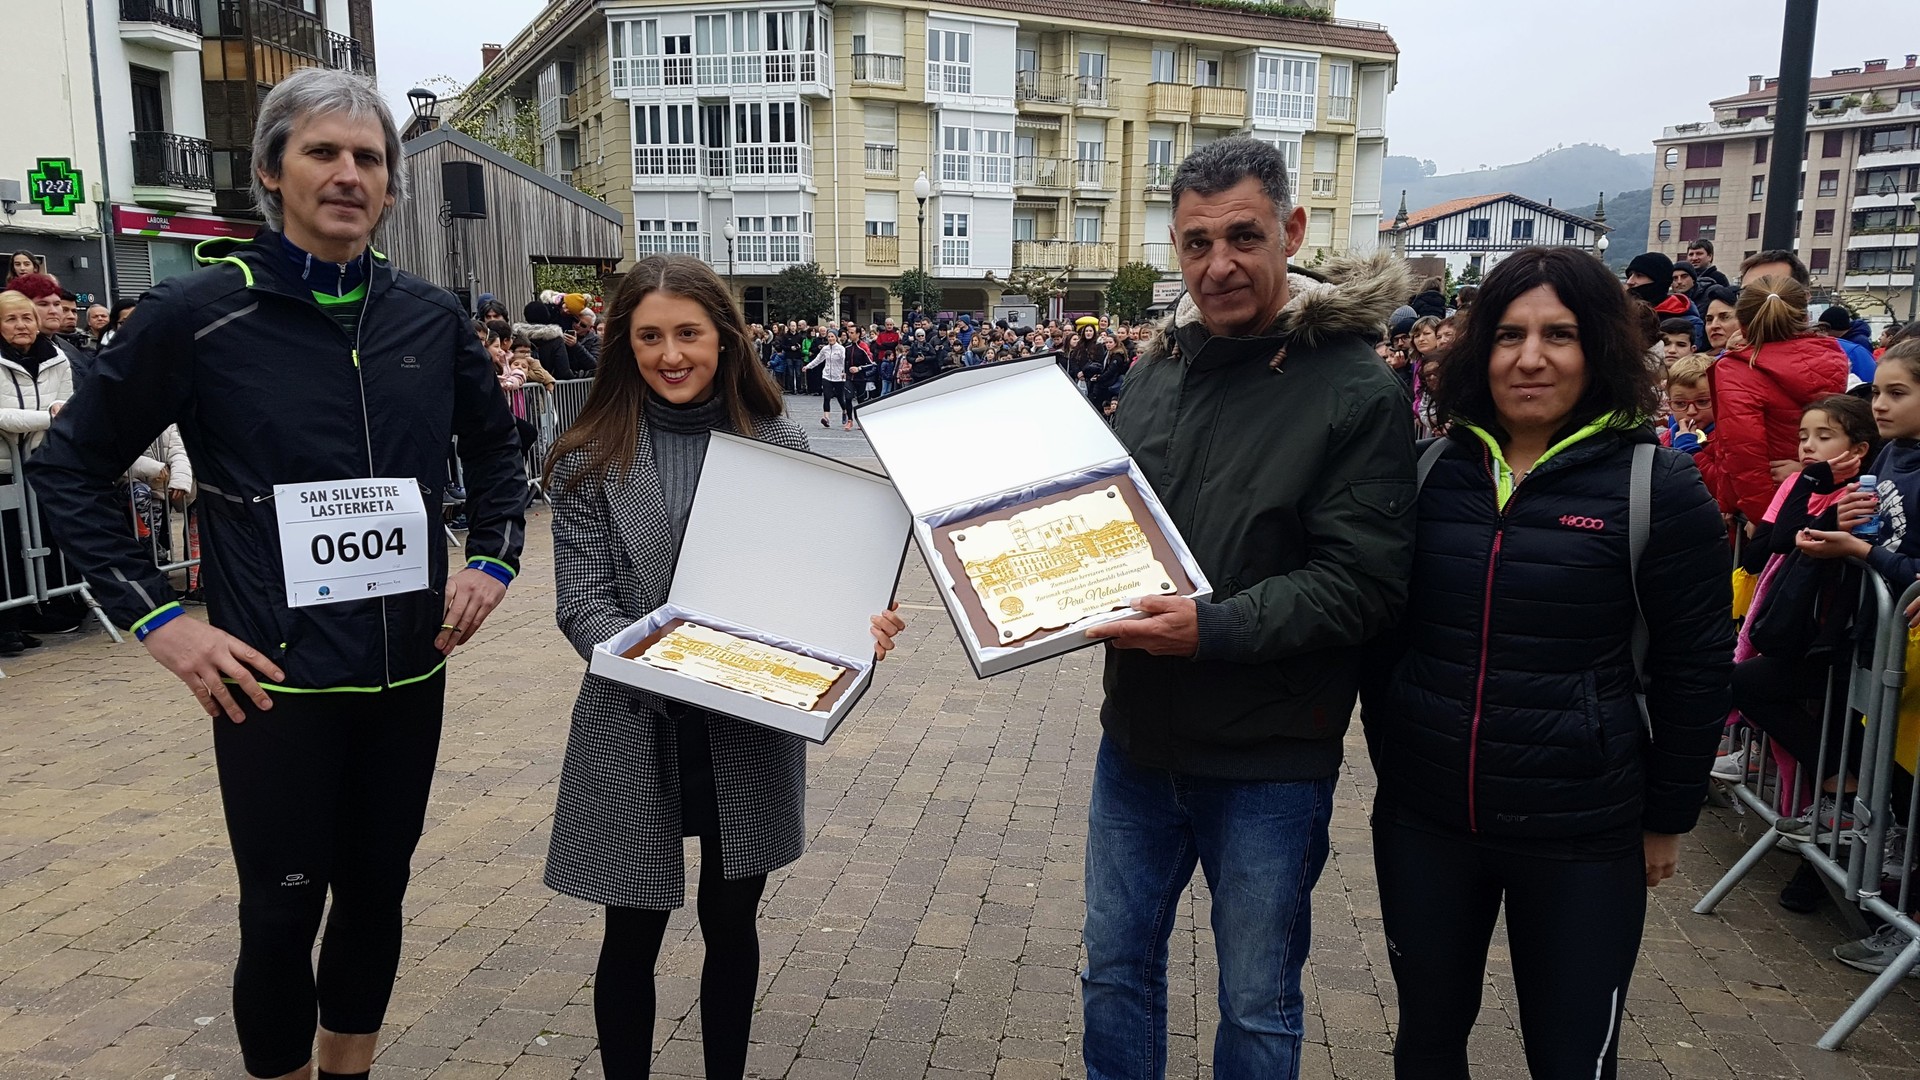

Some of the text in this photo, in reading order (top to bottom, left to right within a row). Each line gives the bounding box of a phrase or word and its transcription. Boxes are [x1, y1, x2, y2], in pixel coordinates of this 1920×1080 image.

[37, 180, 72, 193] 12:27
[146, 216, 170, 225] LABORAL
[300, 485, 400, 504] SAN SILVESTRE
[310, 500, 395, 518] LASTERKETA
[310, 527, 407, 566] 0604
[1057, 596, 1086, 611] Peru
